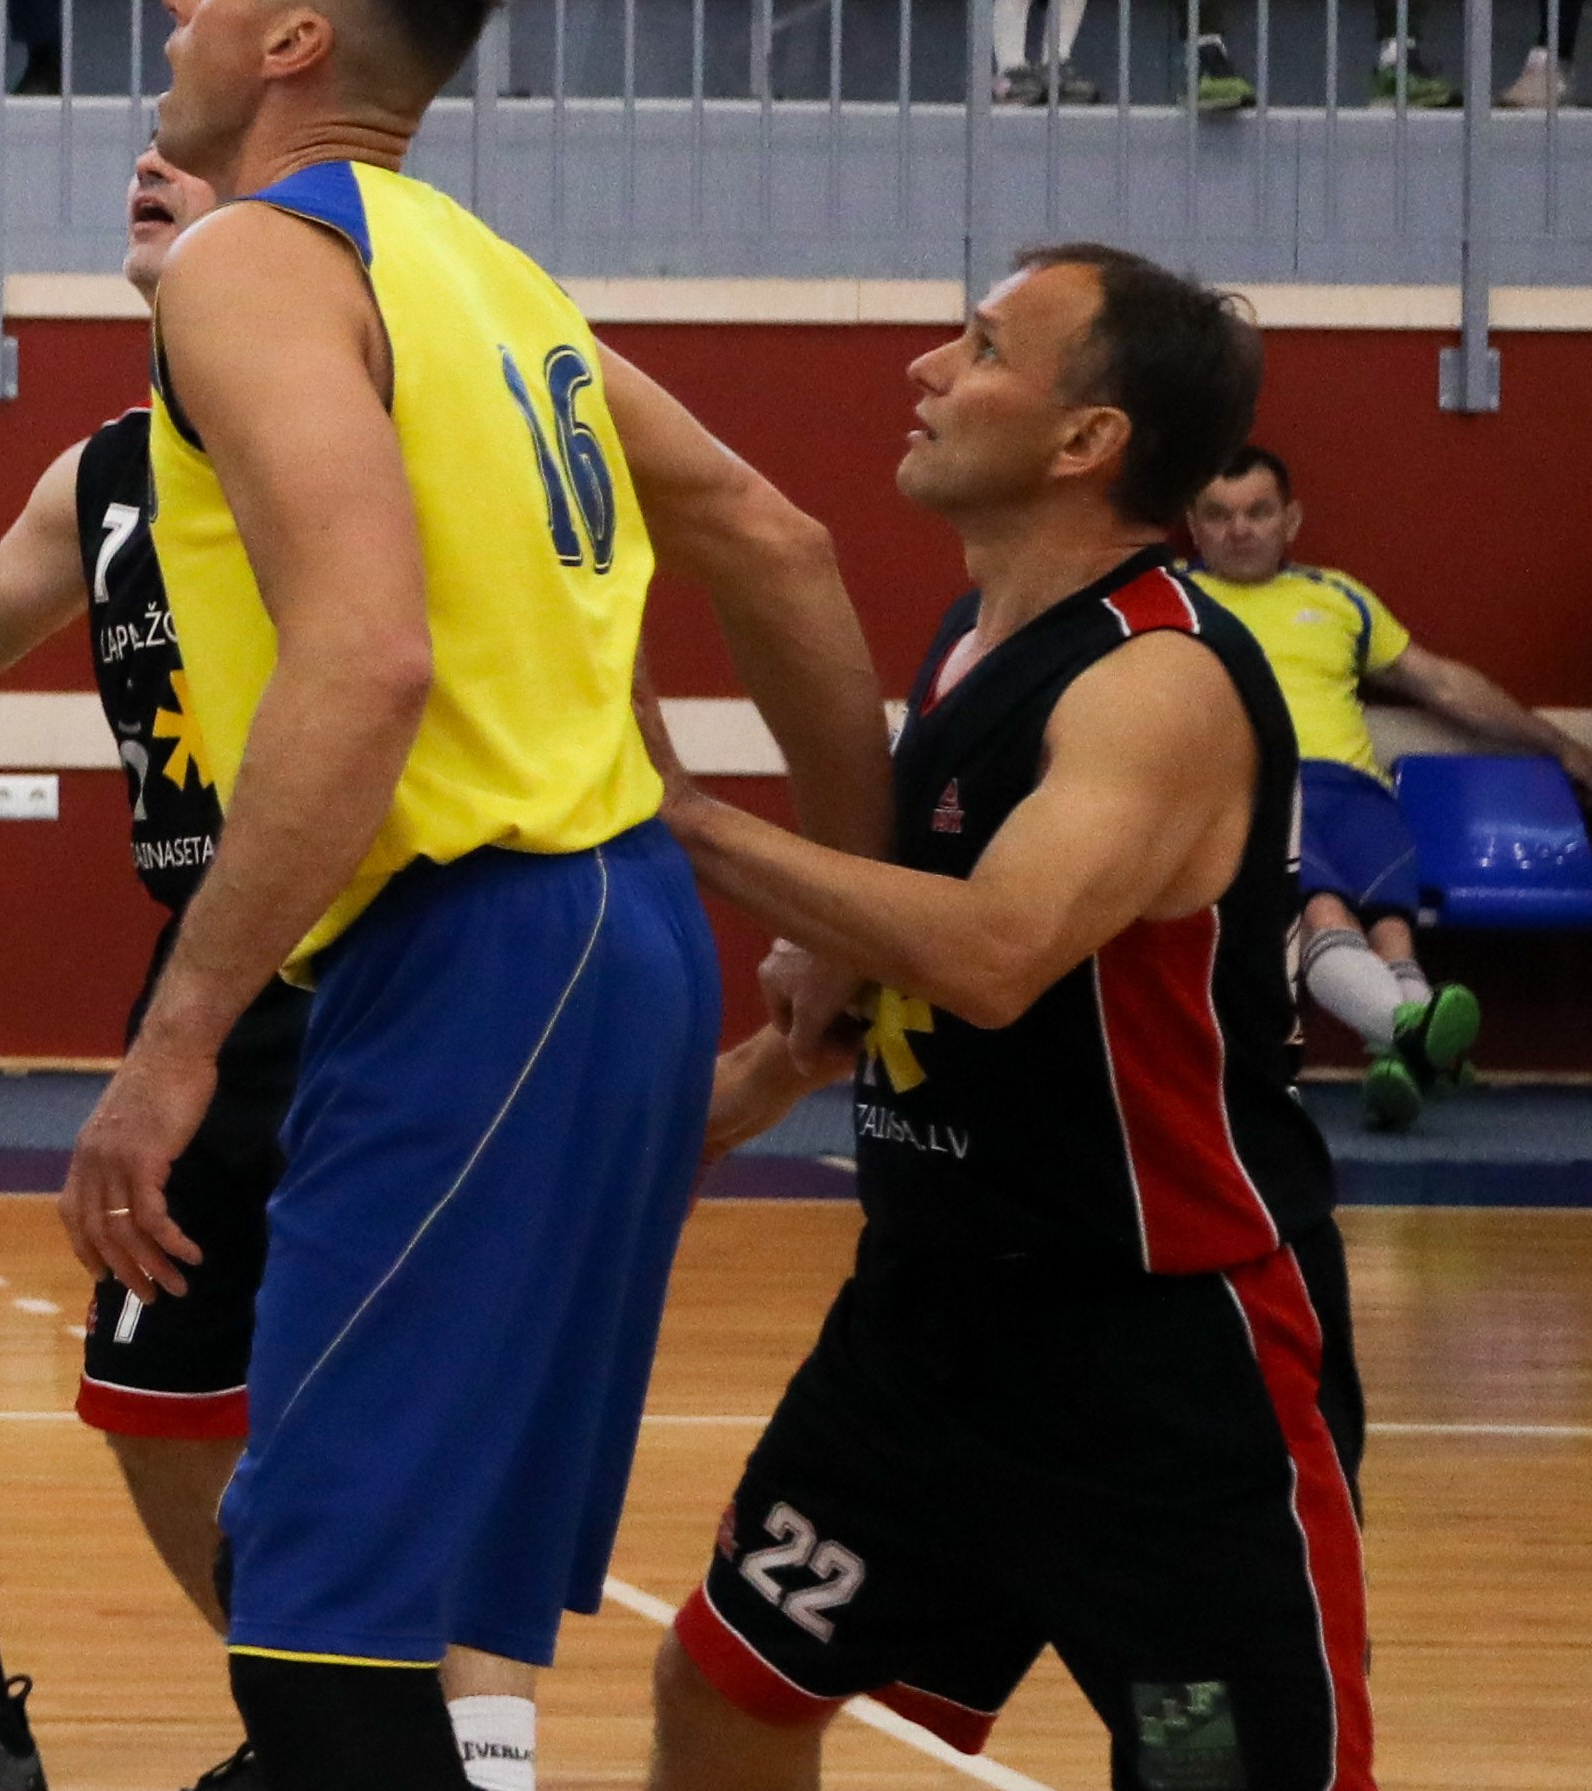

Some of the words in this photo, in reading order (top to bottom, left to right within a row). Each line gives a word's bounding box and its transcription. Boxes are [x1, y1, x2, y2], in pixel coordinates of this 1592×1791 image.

[497, 343, 615, 575] 16
[93, 501, 141, 604] 7
[738, 1500, 866, 1644] 22
